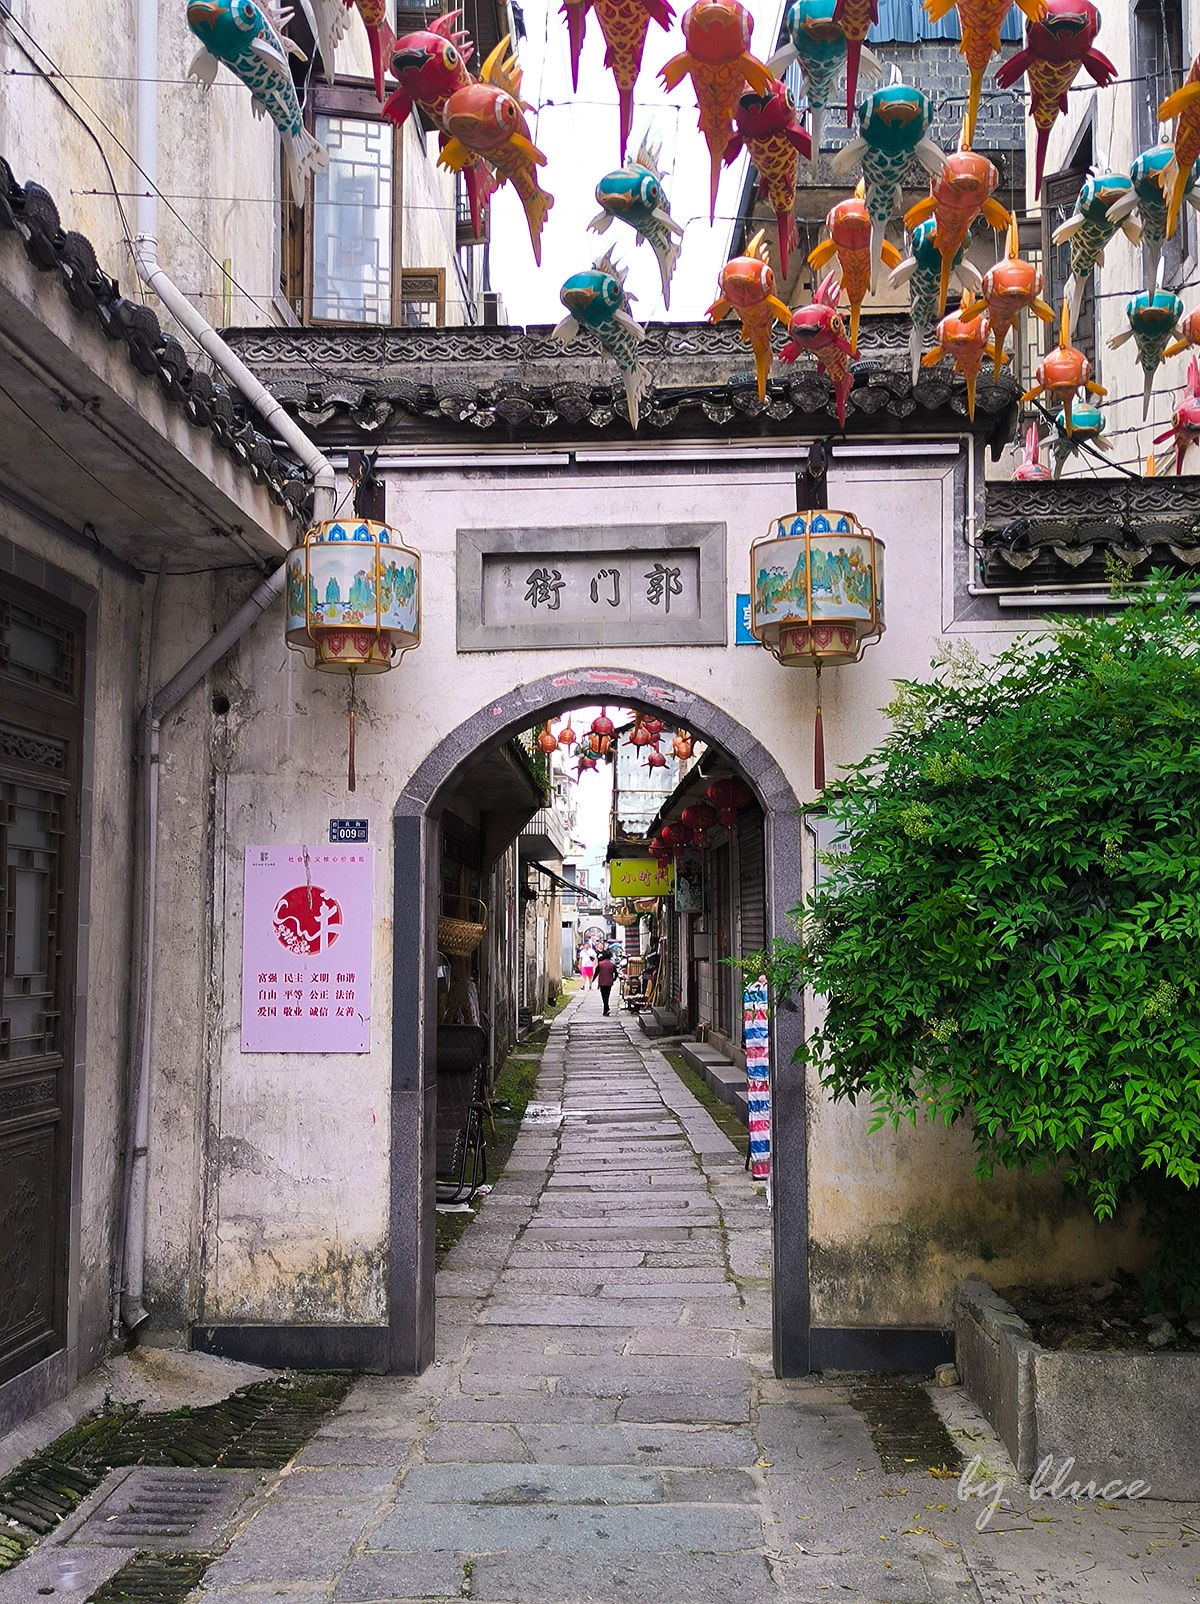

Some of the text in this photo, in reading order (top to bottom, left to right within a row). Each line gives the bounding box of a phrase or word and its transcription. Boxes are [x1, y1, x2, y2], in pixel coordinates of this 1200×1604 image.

[339, 828, 357, 839] 009
[257, 972, 355, 984] 富强 民主 文明 和谐
[258, 989, 355, 1000] 自由 平等 公正 法治
[257, 1006, 355, 1017] 爱国 敬业 诚信 友善
